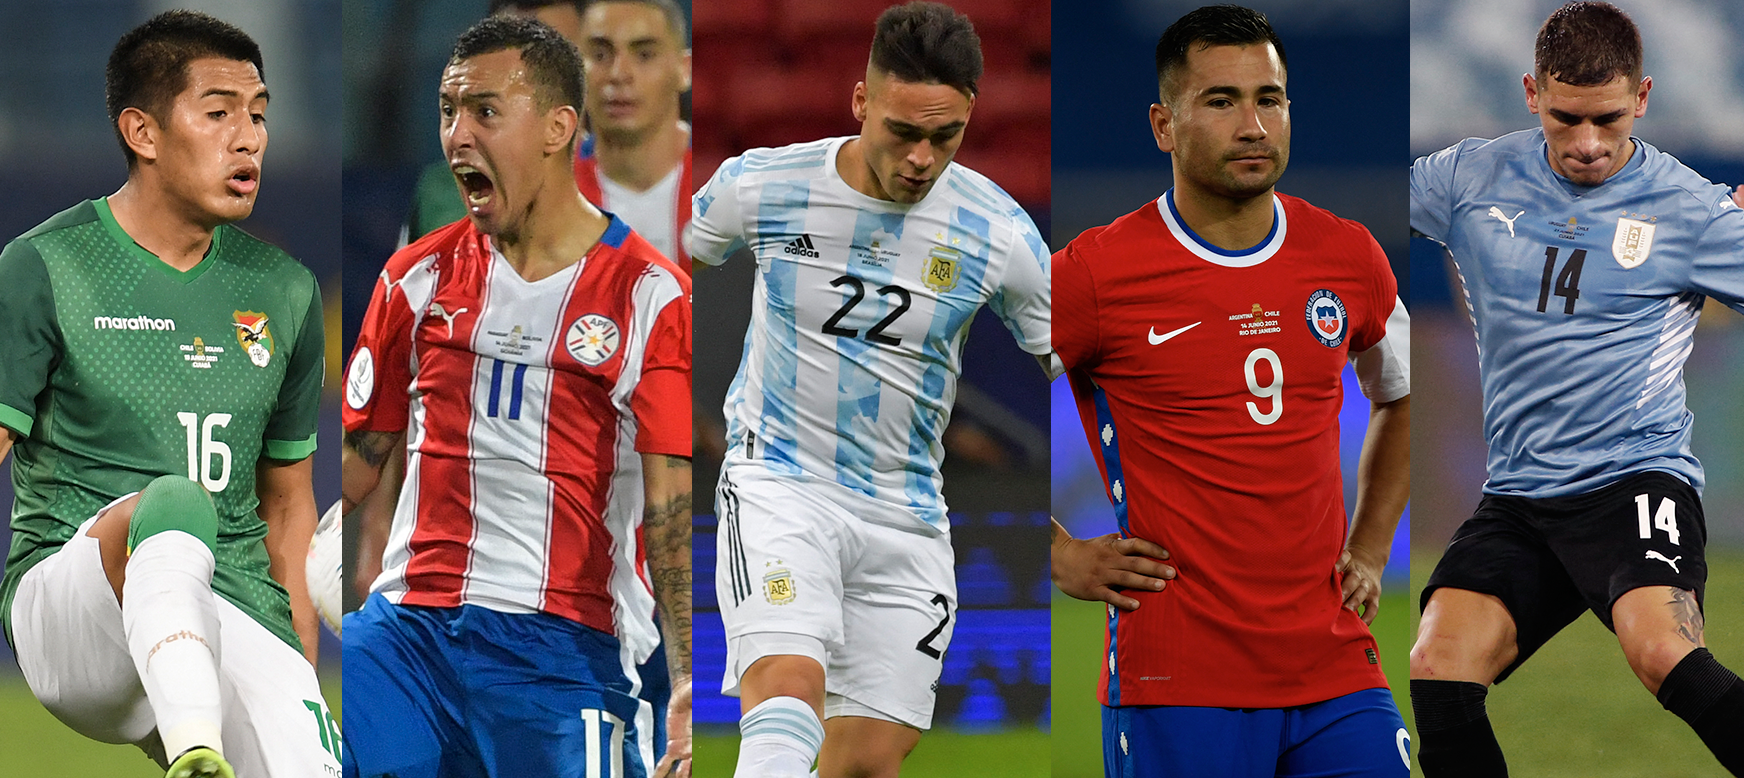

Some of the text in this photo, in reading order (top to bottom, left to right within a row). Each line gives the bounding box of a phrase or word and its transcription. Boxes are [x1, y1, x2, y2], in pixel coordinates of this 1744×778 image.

[784, 246, 819, 258] adidas
[930, 259, 951, 281] AFA
[1536, 246, 1587, 315] 14
[94, 315, 176, 331] marathon
[590, 317, 609, 328] APF
[821, 275, 911, 346] 22
[1228, 313, 1253, 321] ARGENTINA
[487, 359, 528, 420] 11
[1243, 348, 1284, 426] 9
[177, 411, 232, 492] 16
[1635, 493, 1680, 546] 14
[771, 578, 789, 596] AFA
[915, 593, 949, 661] 2
[302, 699, 342, 766] 16
